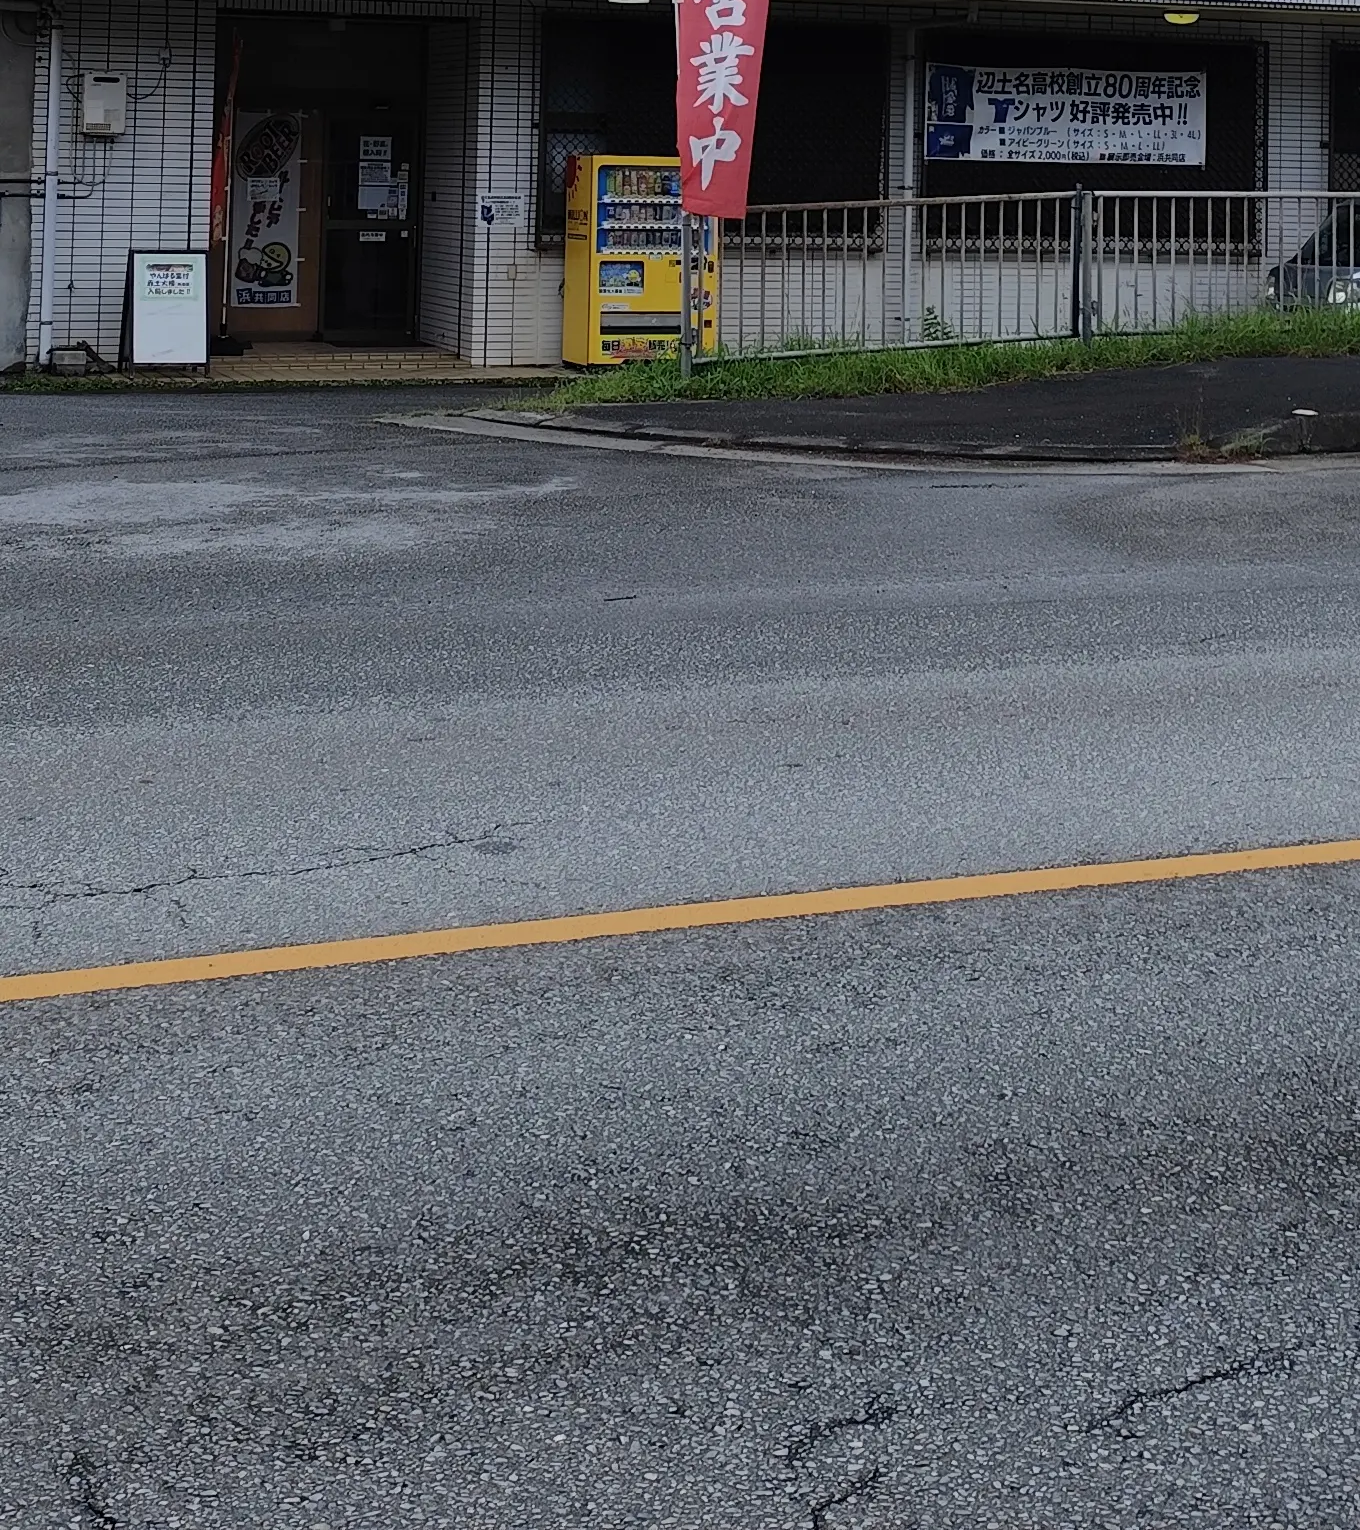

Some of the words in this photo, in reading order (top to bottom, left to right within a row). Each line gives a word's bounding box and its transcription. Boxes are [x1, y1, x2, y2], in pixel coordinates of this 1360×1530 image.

[976, 71, 1201, 99] 辺土名高校創立80周年記念
[238, 290, 291, 304] 浜共同店
